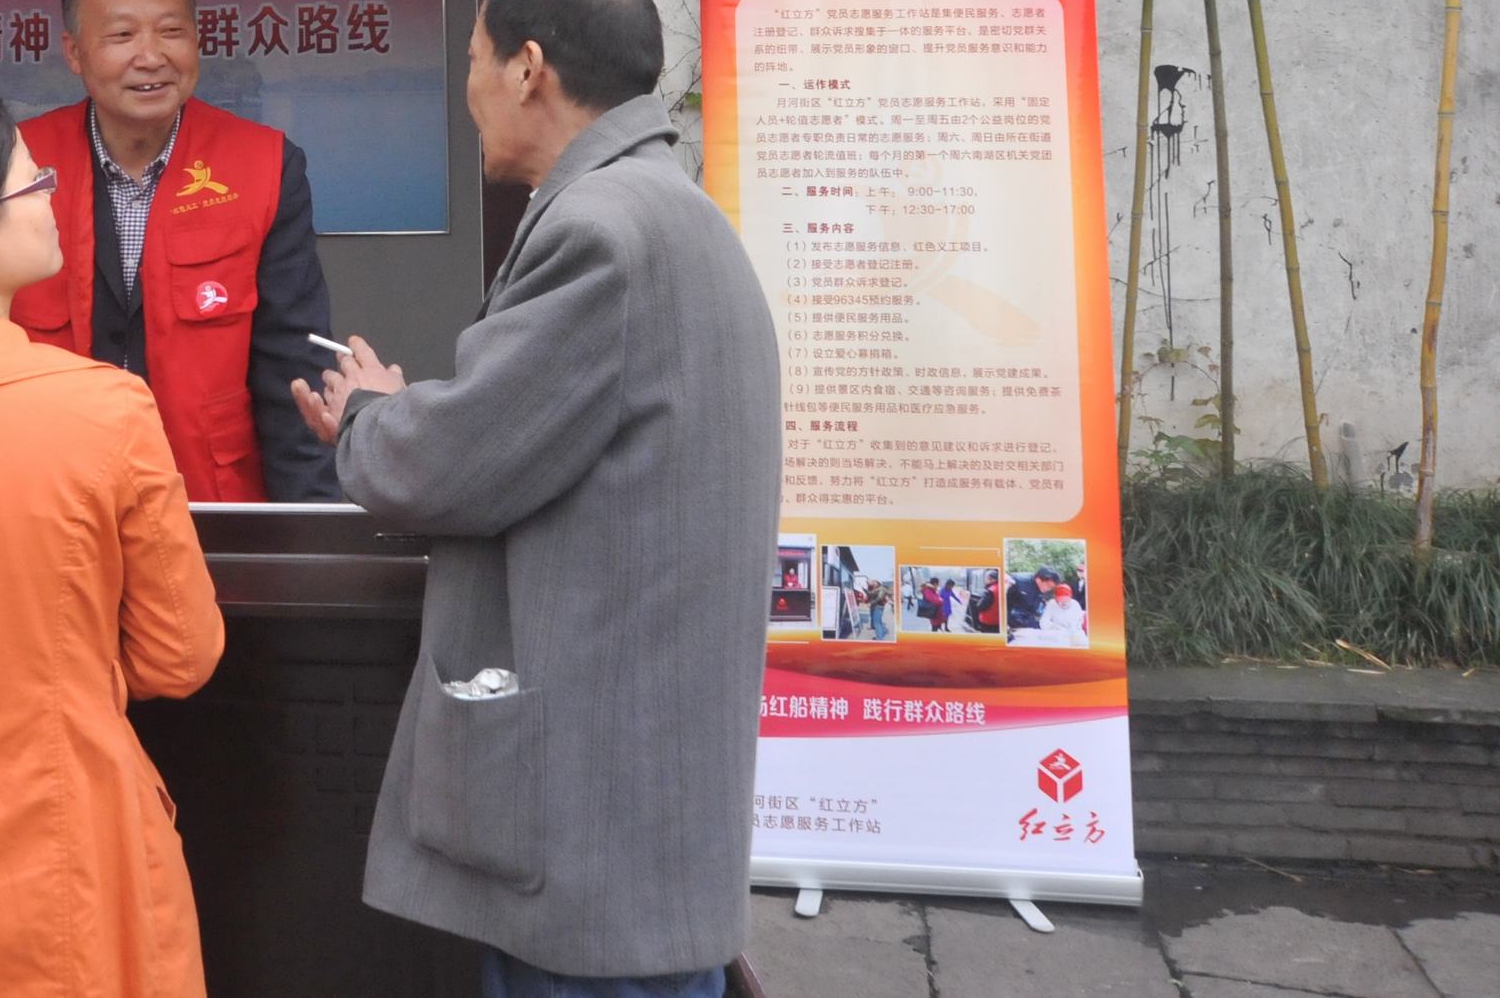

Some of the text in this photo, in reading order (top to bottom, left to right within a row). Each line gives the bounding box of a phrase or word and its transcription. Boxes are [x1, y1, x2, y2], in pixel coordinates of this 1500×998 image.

[197, 3, 390, 57] 群众路线
[863, 698, 987, 725] 践行群众路线
[1018, 808, 1107, 844] 红立方
